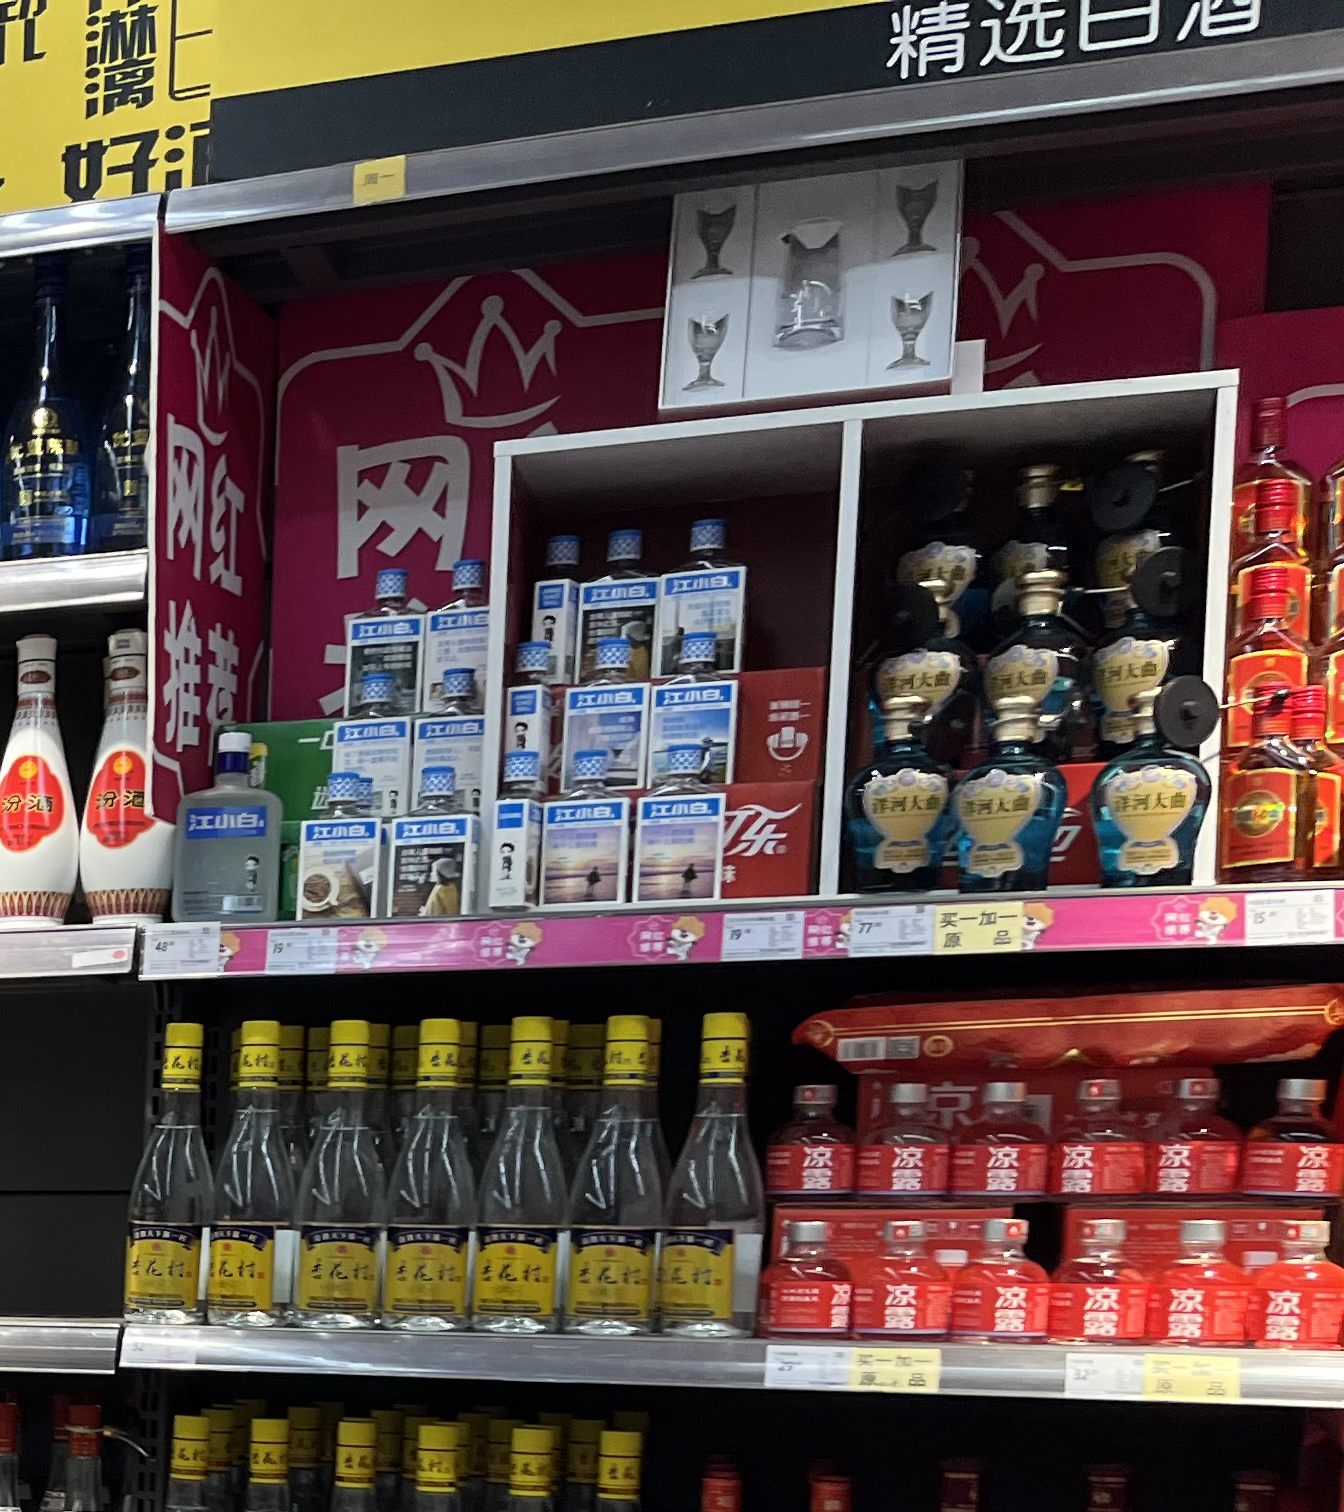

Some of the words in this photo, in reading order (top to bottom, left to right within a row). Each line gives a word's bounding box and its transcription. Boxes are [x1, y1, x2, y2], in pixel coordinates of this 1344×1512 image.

[166, 413, 246, 597] 网红
[590, 585, 650, 603] 江小白
[672, 577, 734, 594] 江小白
[357, 620, 413, 639] 江小白
[578, 690, 637, 707] 江小白
[664, 688, 725, 705] 江小白
[344, 724, 400, 741] 江小白
[426, 721, 482, 738] 江小白
[0, 793, 55, 815] 汾酒
[651, 802, 712, 819] 江小白
[187, 810, 265, 833] 江小白
[554, 806, 616, 822] 江小白
[312, 824, 370, 841] 江小白
[401, 821, 460, 839] 江小白
[940, 910, 1019, 928] 买一加一
